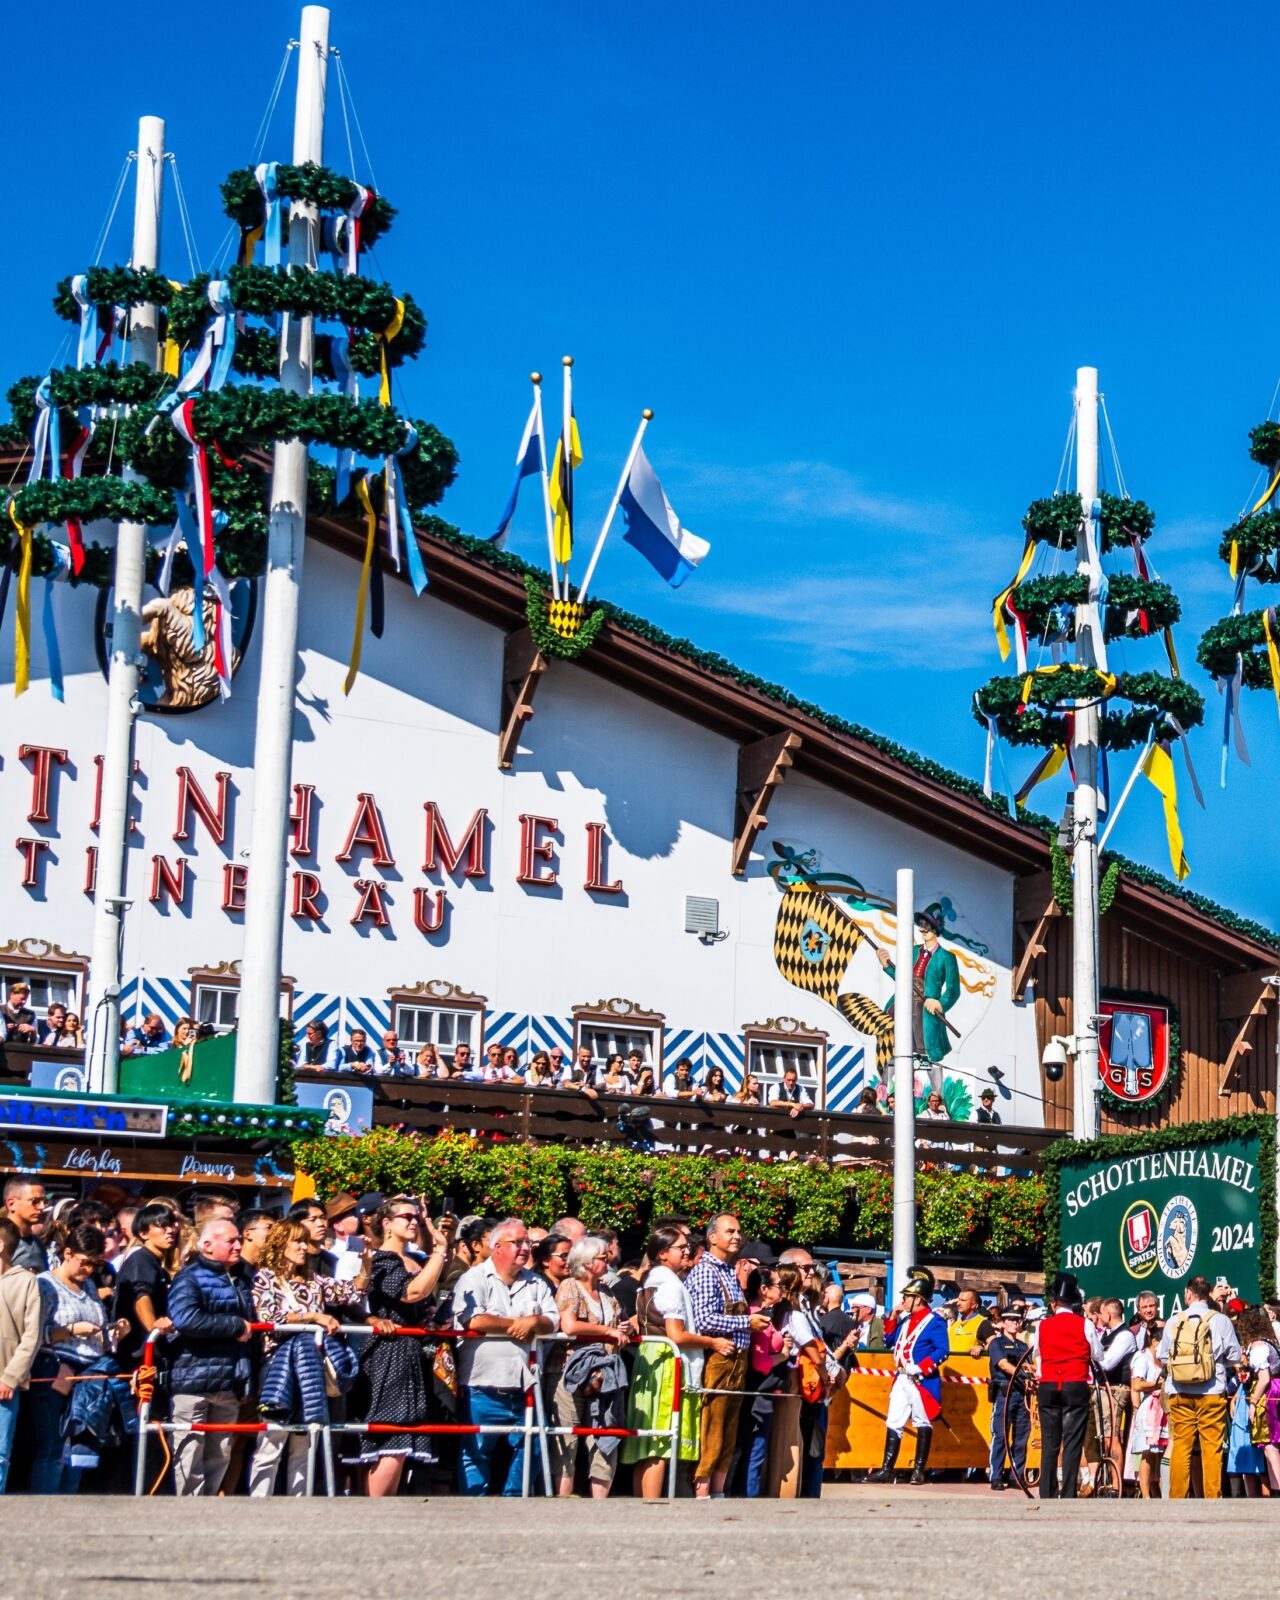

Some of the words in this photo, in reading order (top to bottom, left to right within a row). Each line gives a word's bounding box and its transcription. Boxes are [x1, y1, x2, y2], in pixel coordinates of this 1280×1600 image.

[1110, 1069, 1122, 1083] G
[1140, 1072, 1152, 1087] S
[180, 1155, 235, 1181] Pommes
[1065, 1150, 1255, 1217] SCHOTTENHAMEL
[1065, 1241, 1102, 1269] 1867
[1211, 1222, 1255, 1252] 2024
[1129, 1247, 1156, 1268] SPATEN
